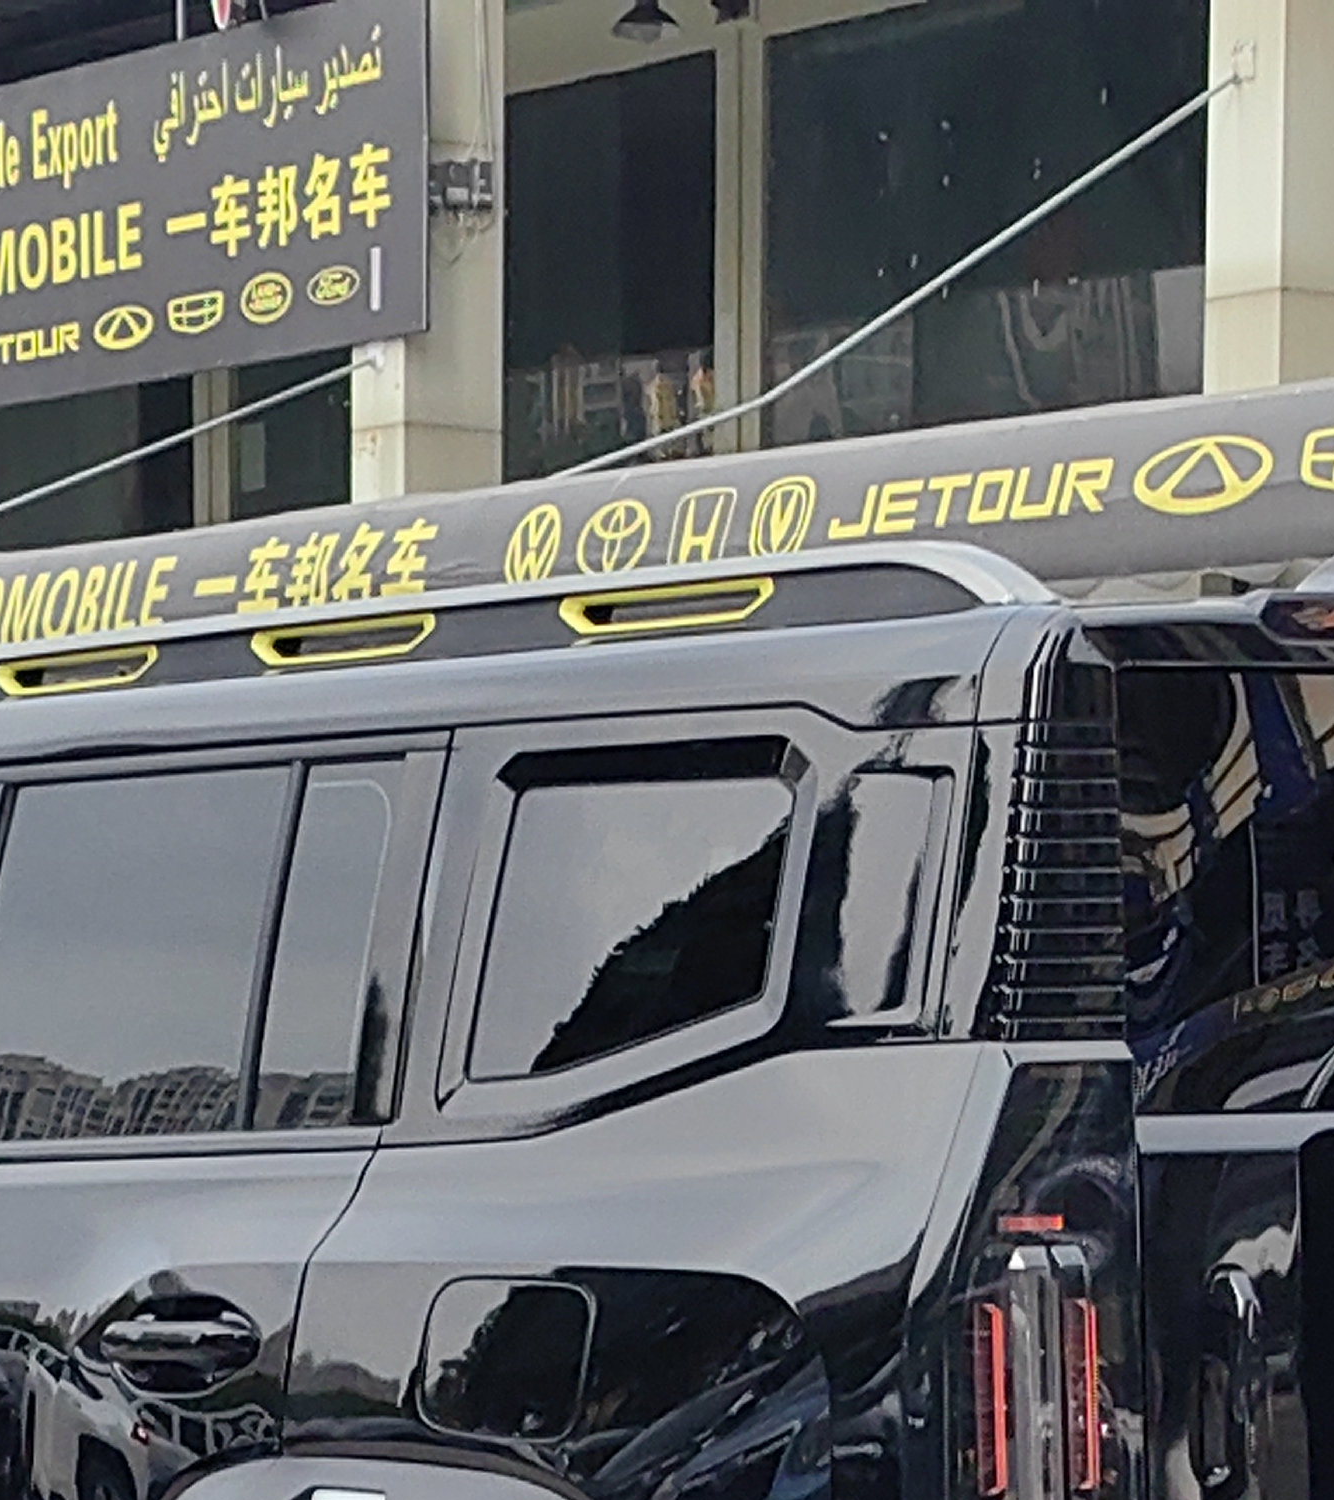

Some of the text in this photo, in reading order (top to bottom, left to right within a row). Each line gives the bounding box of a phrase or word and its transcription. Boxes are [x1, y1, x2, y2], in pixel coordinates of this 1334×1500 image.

[153, 57, 229, 163] احترافي
[234, 44, 309, 128] سيارات
[30, 101, 119, 189] Export
[166, 142, 392, 258] 一车邦名车
[827, 457, 1115, 540] JETOUR
[194, 517, 440, 616] 一车邦名车
